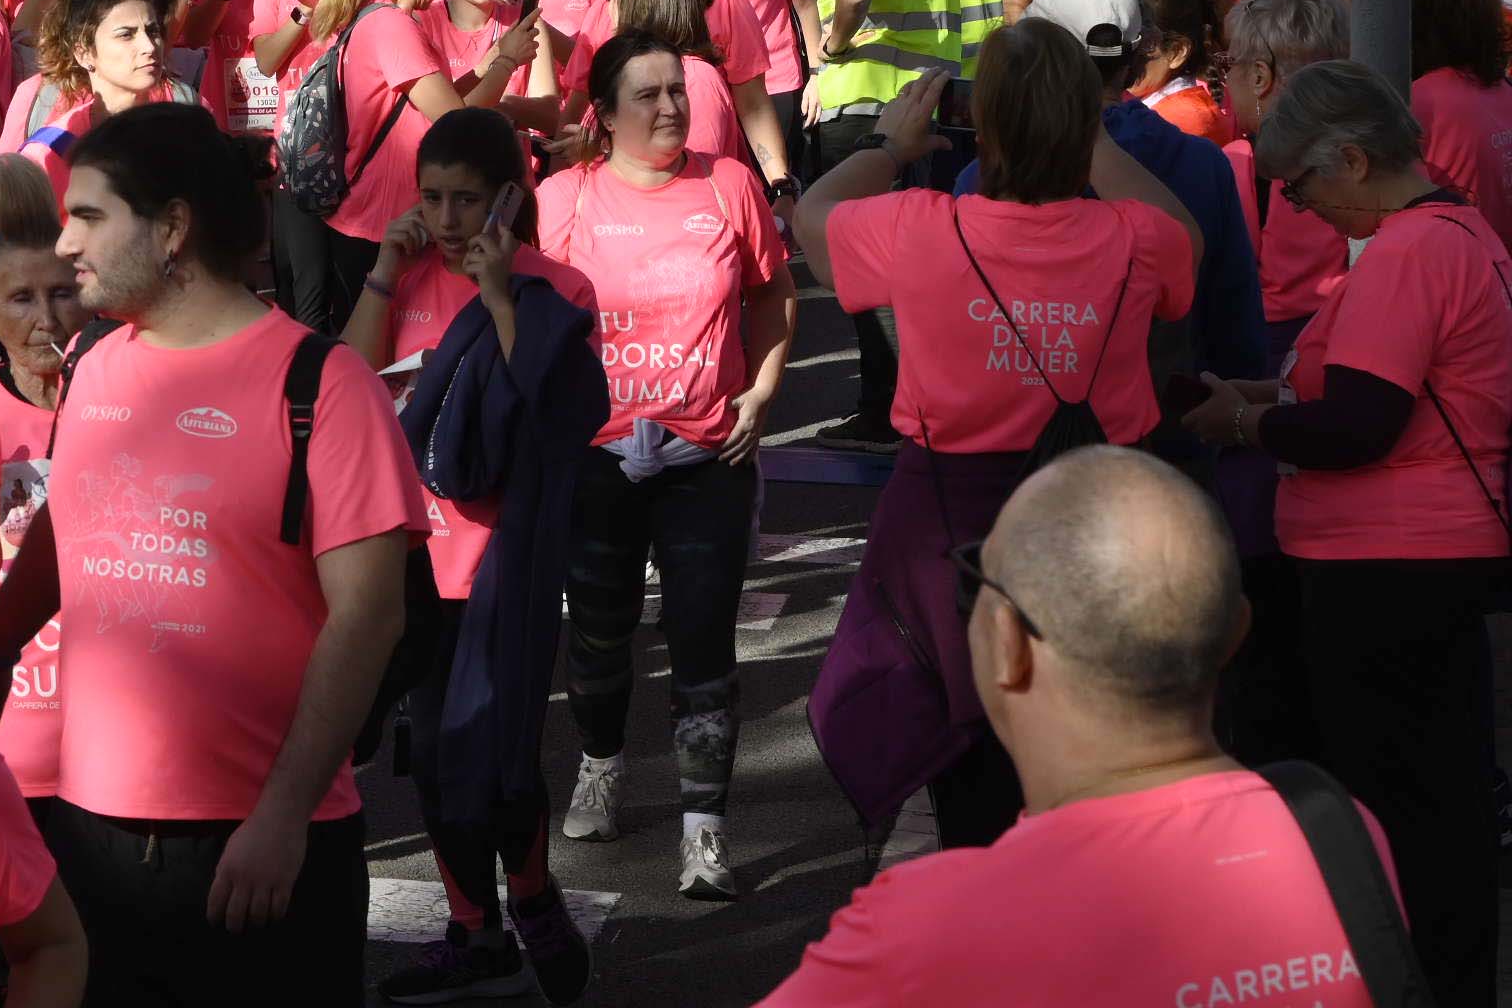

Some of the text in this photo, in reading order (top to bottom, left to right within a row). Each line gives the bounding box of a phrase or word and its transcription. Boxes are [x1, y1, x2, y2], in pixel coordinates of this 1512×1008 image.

[252, 86, 279, 96] 016
[594, 224, 644, 236] OYSHO
[599, 310, 633, 333] TU
[967, 298, 1099, 326] CARRERA
[993, 325, 1075, 350] DE LA
[601, 343, 717, 369] DORSAL
[985, 351, 1079, 373] MUJER
[1021, 377, 1046, 385] 2023
[81, 405, 131, 422] OYSHO
[182, 415, 232, 434] ASTURIANA
[160, 508, 207, 530] POR
[130, 531, 208, 558] TODAS
[83, 557, 207, 588] NOSOTRAS
[182, 625, 207, 634] 2021
[12, 701, 48, 709] CARRERA
[1175, 949, 1361, 1008] CARRERA
